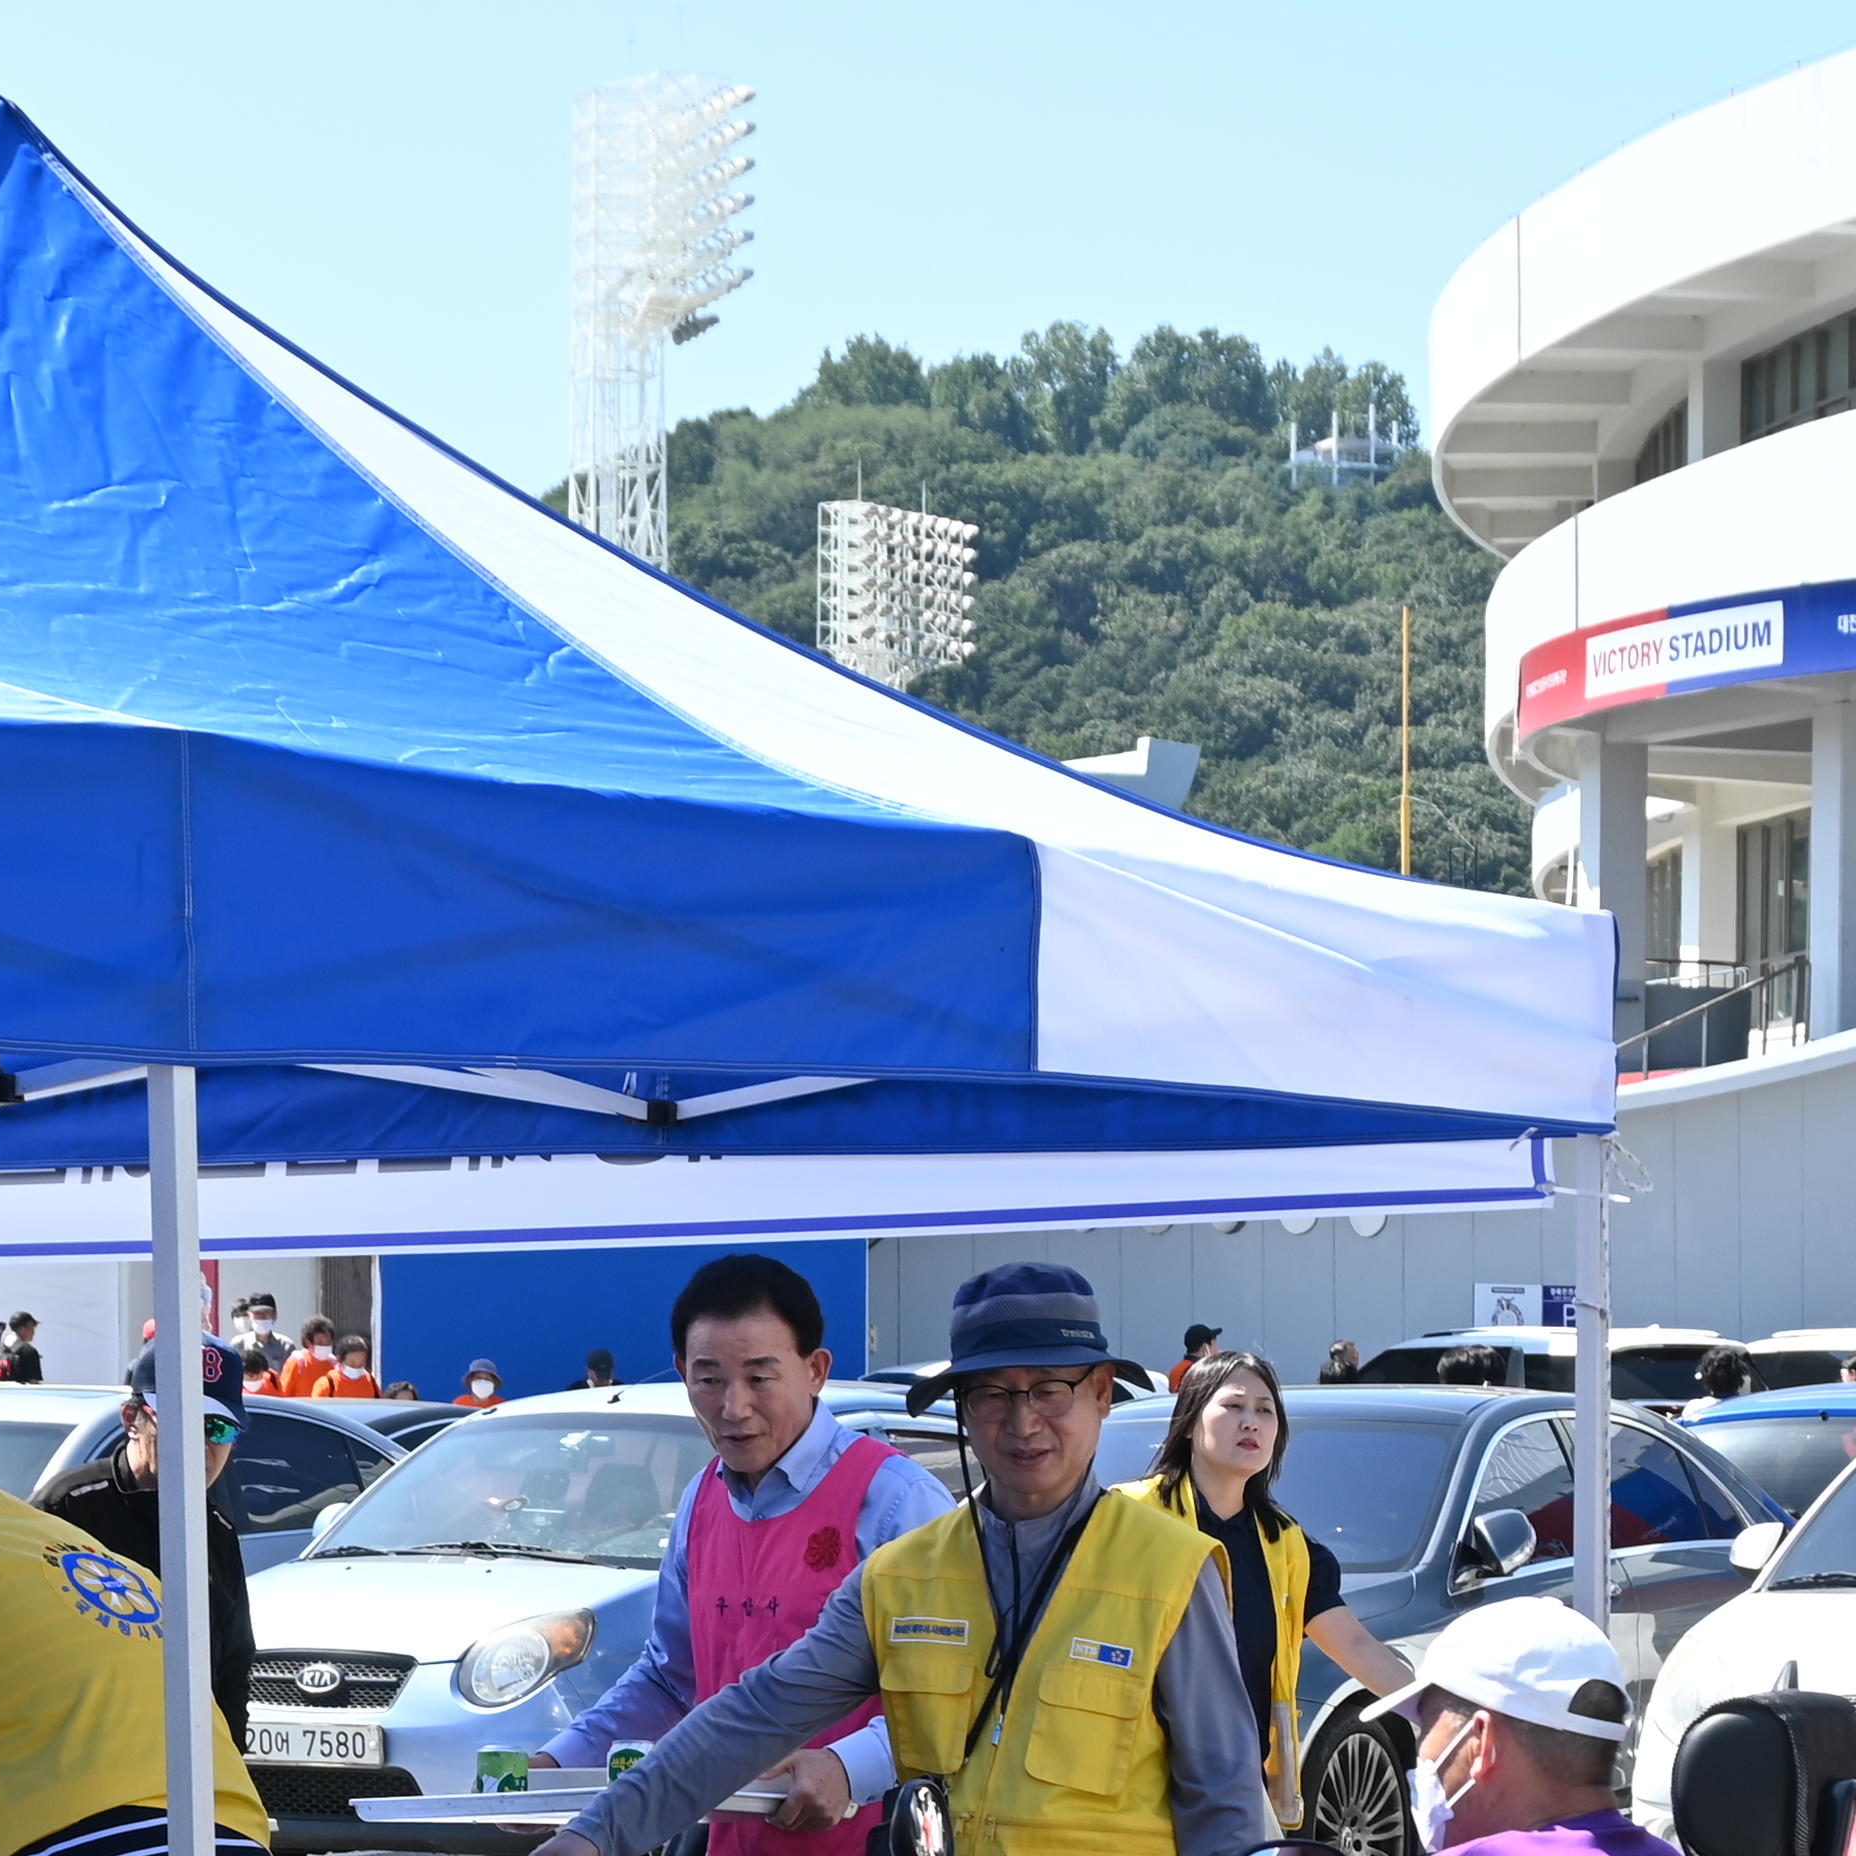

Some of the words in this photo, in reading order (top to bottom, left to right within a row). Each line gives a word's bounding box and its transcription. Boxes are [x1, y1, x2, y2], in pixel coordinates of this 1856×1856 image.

[1593, 638, 1663, 678] VICTORY
[1668, 619, 1772, 662] STADIUM
[302, 1669, 332, 1687] KIA
[302, 1730, 366, 1759] 7580
